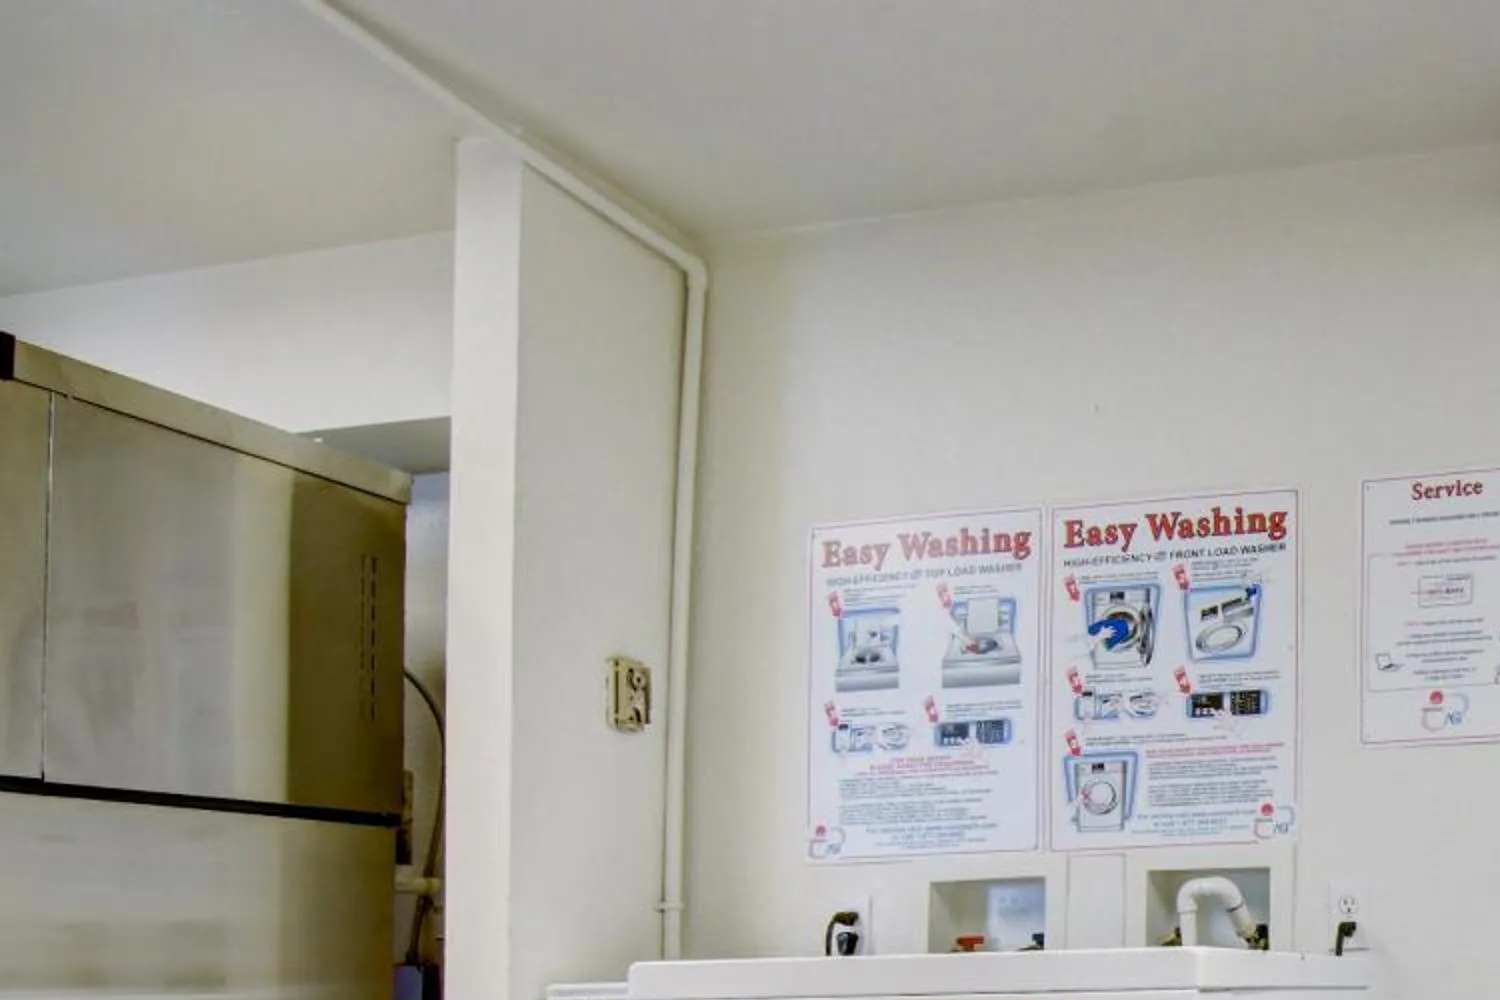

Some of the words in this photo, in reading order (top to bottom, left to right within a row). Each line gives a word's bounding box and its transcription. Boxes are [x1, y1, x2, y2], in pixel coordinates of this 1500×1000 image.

[1411, 480, 1484, 501] Service
[1063, 519, 1138, 552] Easy
[1145, 506, 1288, 541] Washing
[821, 539, 891, 571] Easy
[896, 527, 1033, 561] Washing
[1063, 552, 1152, 568] HIGH-EFFICIENCY
[1169, 549, 1202, 561] FRONT
[1207, 546, 1240, 558] LOAD
[1241, 543, 1287, 556] WASHER
[947, 565, 977, 577] LOAD
[978, 562, 1023, 575] WASHER
